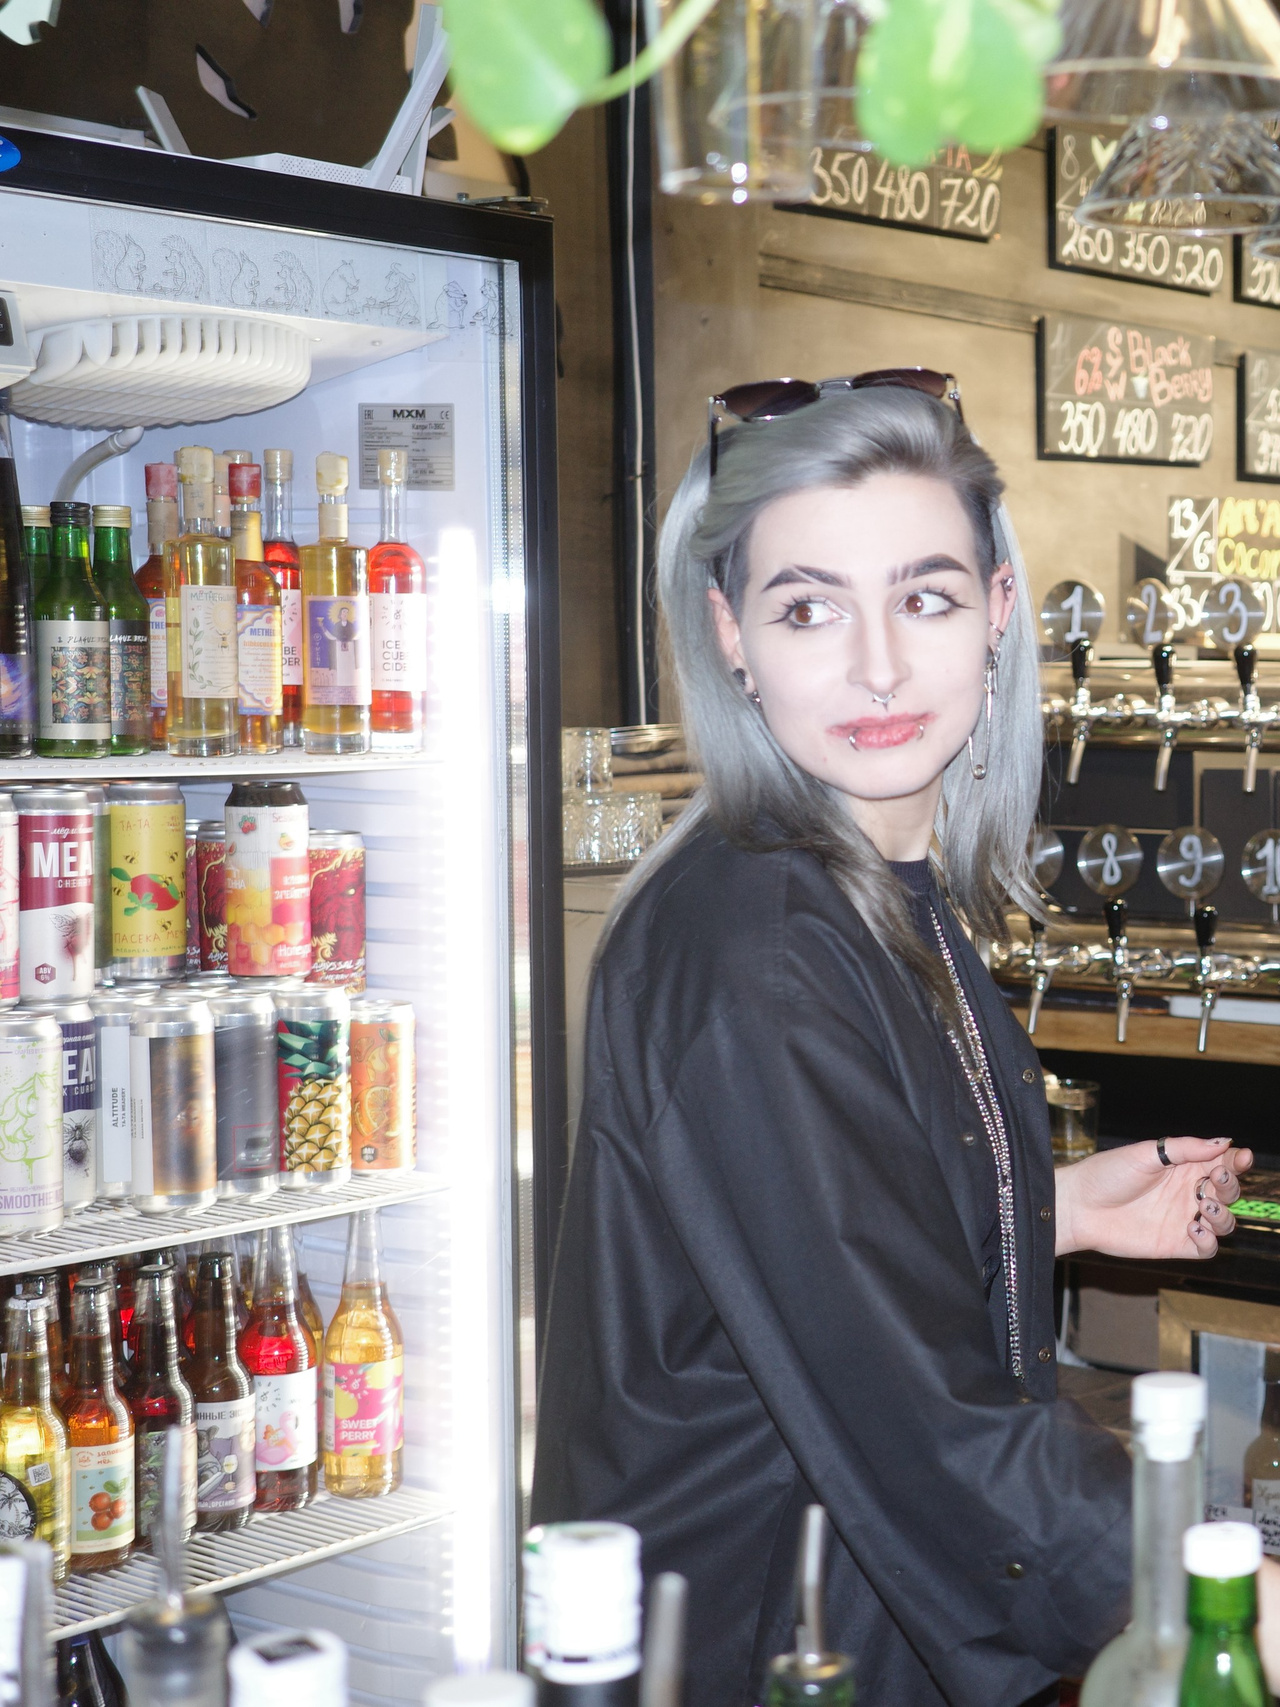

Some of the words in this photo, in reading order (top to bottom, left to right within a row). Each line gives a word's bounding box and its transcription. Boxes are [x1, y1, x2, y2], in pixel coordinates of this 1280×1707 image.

[1061, 134, 1080, 180] 8
[809, 147, 868, 205] 350
[872, 158, 930, 220] 480
[939, 177, 1000, 235] 720
[1120, 231, 1170, 276] 350
[1172, 244, 1223, 288] 520
[1127, 329, 1192, 374] Black
[1150, 362, 1214, 408] Berry
[1058, 401, 1106, 454] 350
[1113, 408, 1158, 456] 480
[1169, 412, 1214, 462] 720
[1168, 498, 1198, 539] 13
[1060, 586, 1087, 642] 1
[1142, 585, 1164, 642] 2
[1219, 583, 1249, 642] 3
[382, 640, 400, 649] ICE
[32, 841, 94, 878] MEA
[1102, 833, 1121, 885] 8
[1179, 829, 1202, 887] 9
[58, 878, 91, 889] CHERRY
[113, 928, 160, 945] ПАСЕКА
[39, 967, 52, 975] ABV
[63, 1046, 95, 1087] EA
[341, 1419, 377, 1429] SWEET
[341, 1430, 376, 1440] PERRY
